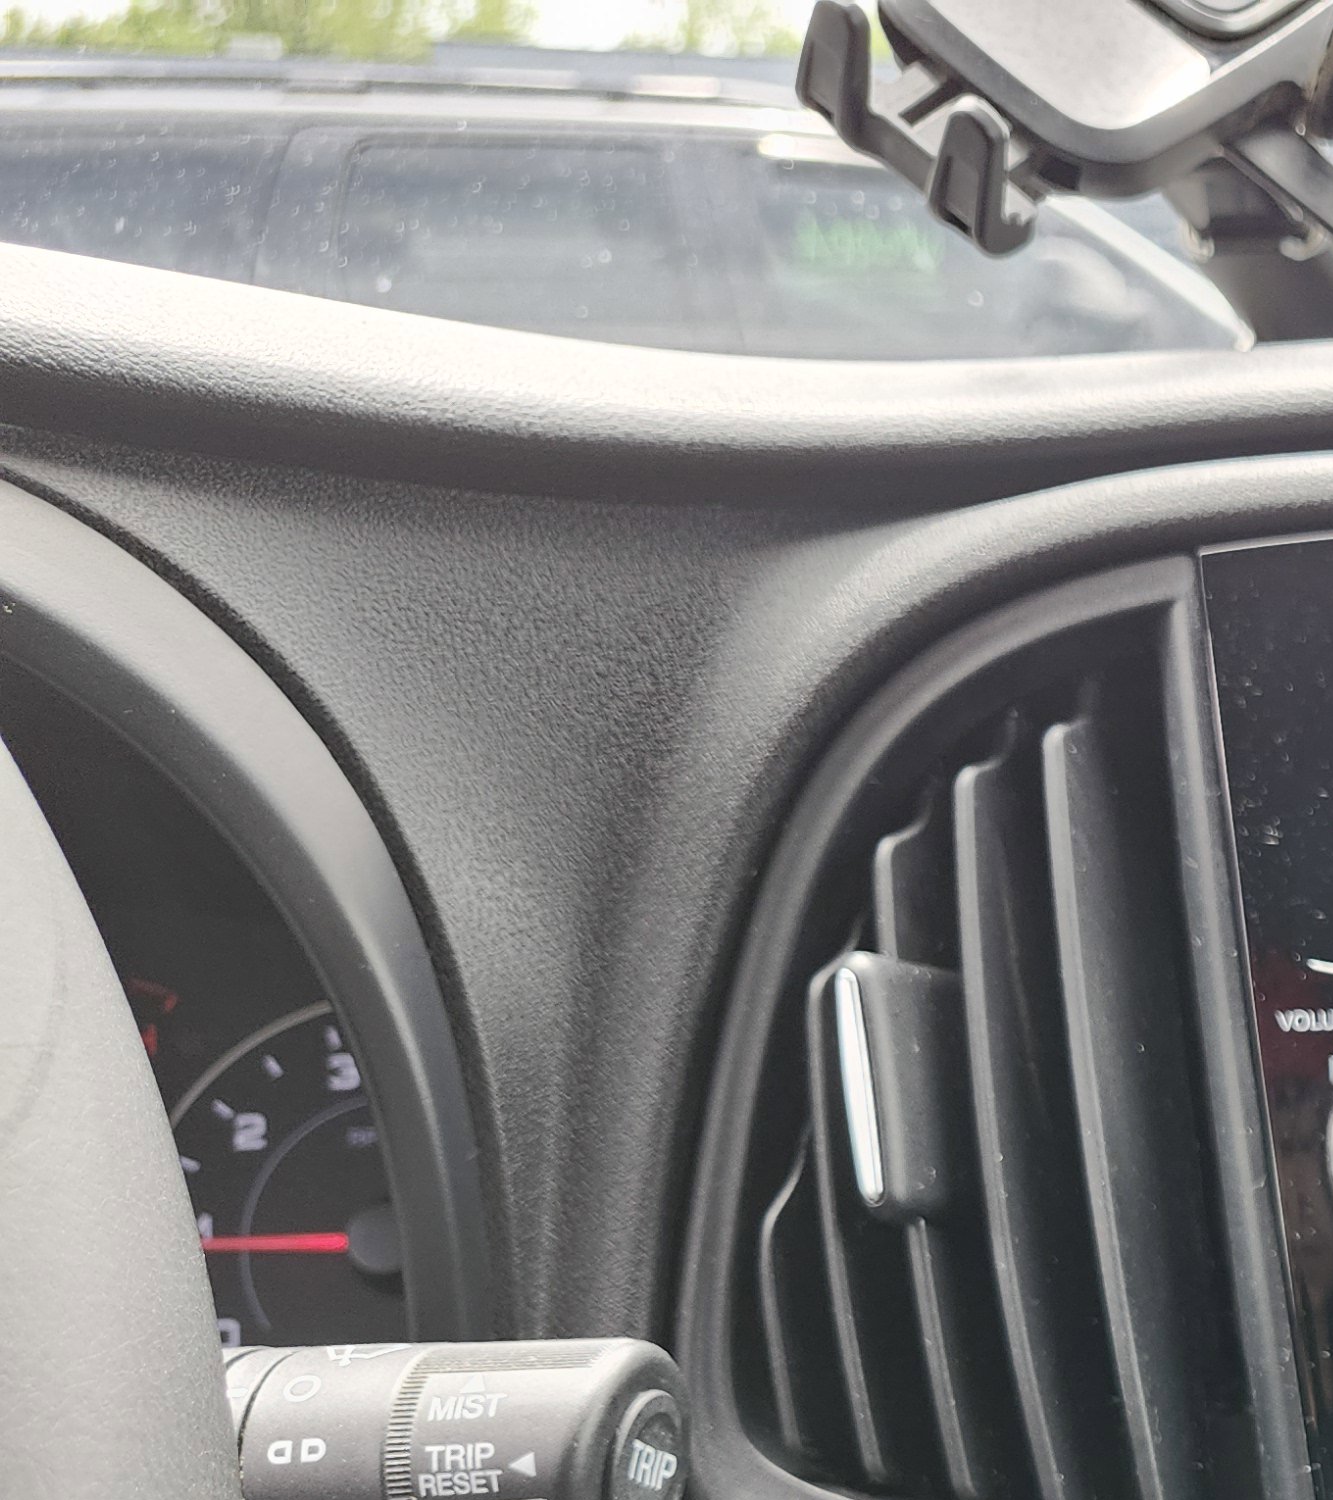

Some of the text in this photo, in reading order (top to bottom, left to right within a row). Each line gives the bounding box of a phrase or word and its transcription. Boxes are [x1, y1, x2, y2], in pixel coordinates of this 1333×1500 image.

[232, 1111, 268, 1152] 2
[427, 1393, 508, 1421] MIST
[425, 1442, 495, 1472] TRIP
[628, 1438, 678, 1490] TRIP
[418, 1469, 503, 1497] RESET
